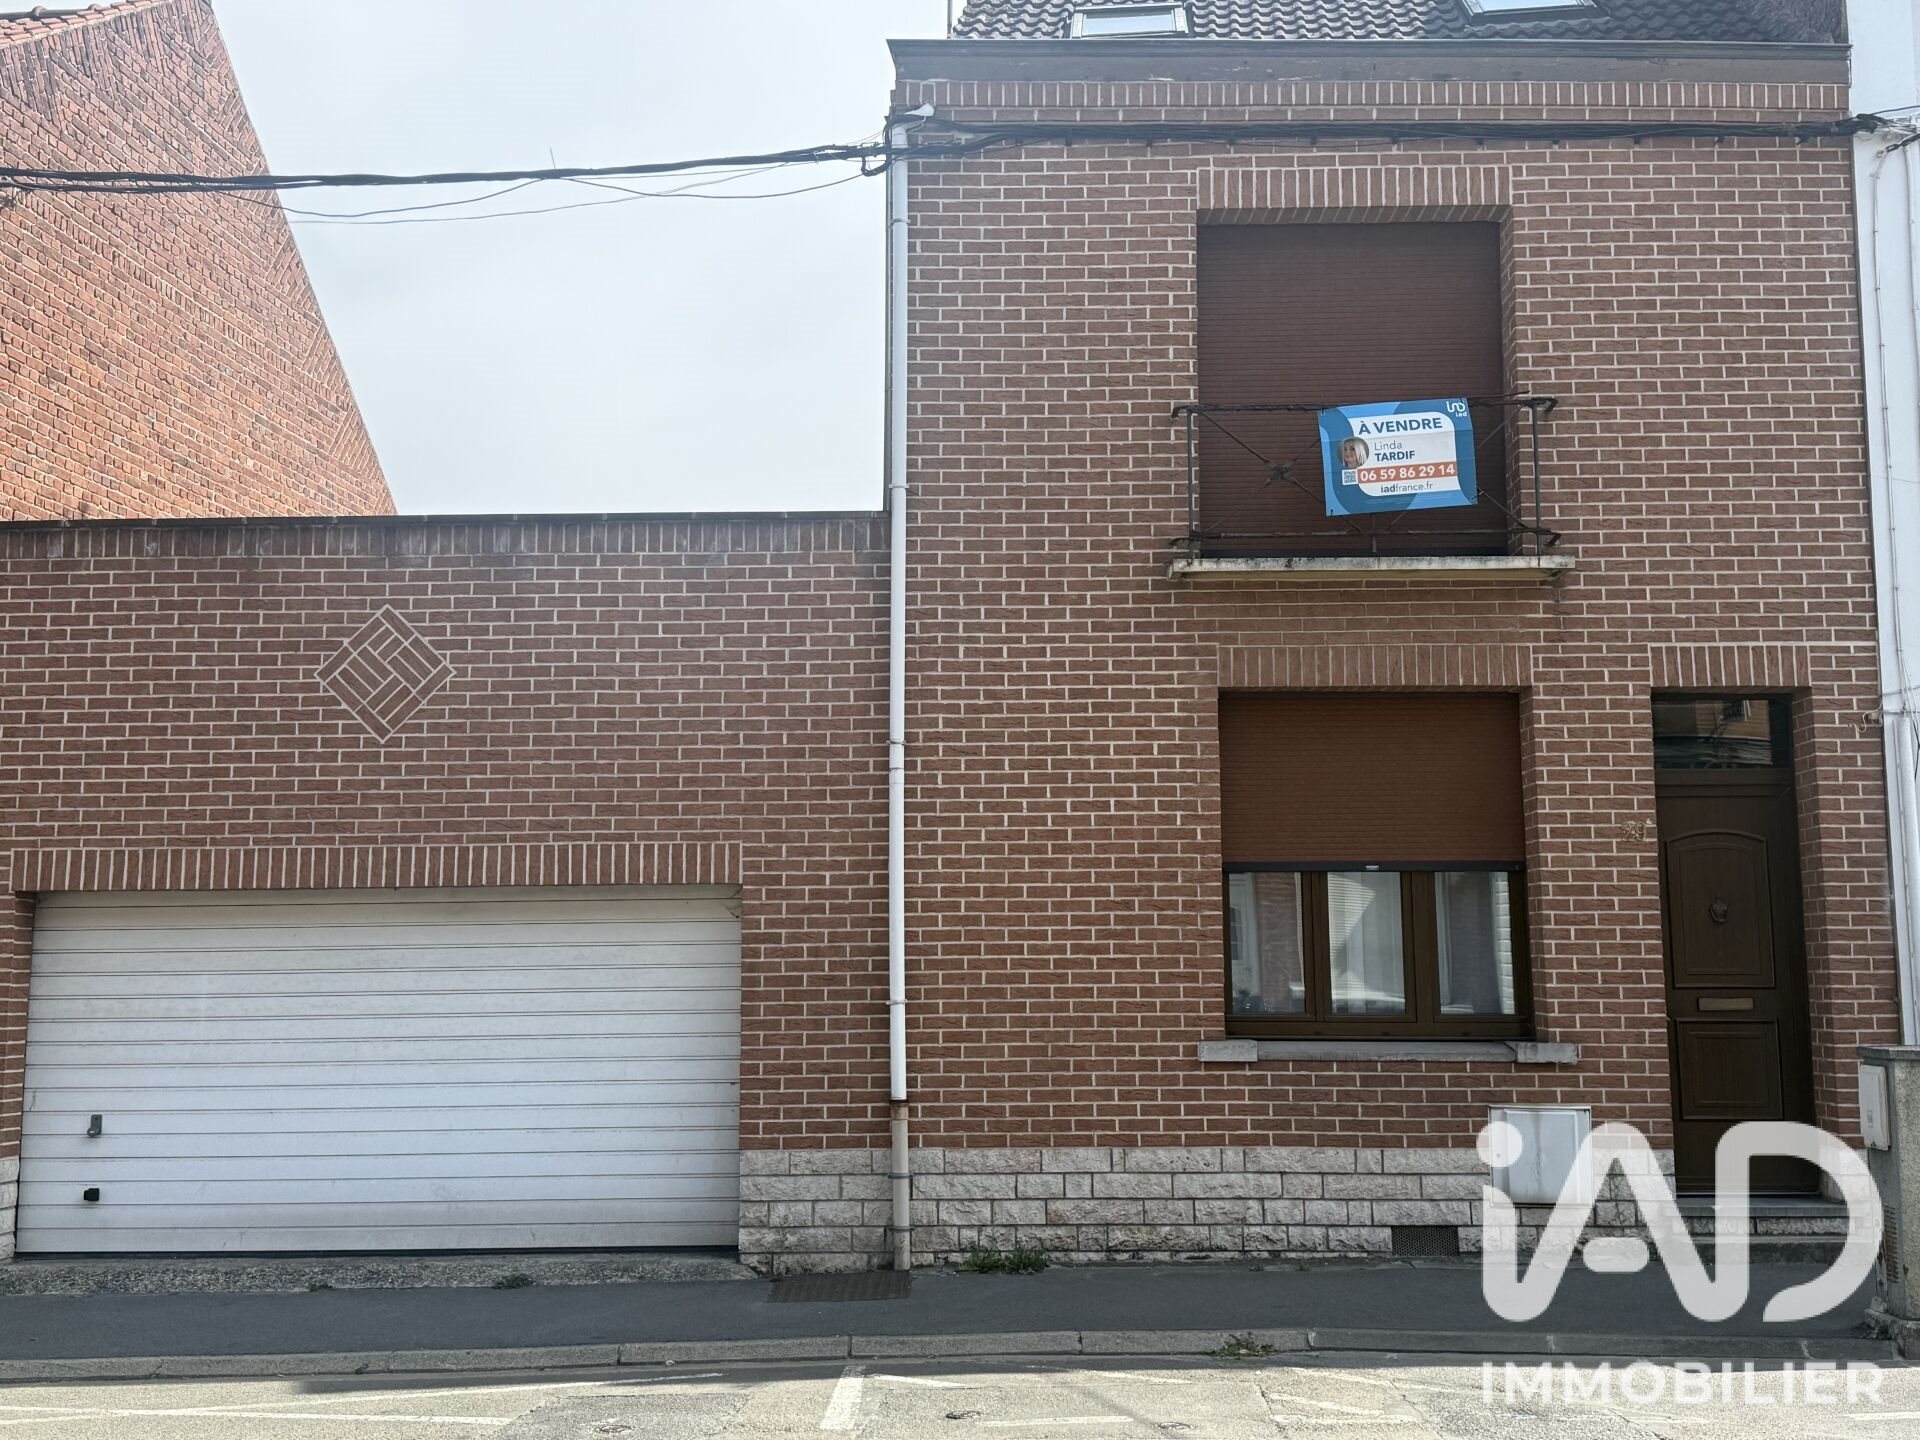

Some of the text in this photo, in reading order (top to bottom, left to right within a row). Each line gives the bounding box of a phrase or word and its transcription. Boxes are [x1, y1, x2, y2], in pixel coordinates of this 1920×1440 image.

[1358, 417, 1443, 435] À VENDRE
[1374, 440, 1403, 451] Linda
[1374, 450, 1416, 462] TARDIF
[1360, 464, 1455, 482] 06 59 86 29 14
[1380, 481, 1434, 493] iadfrance.fr
